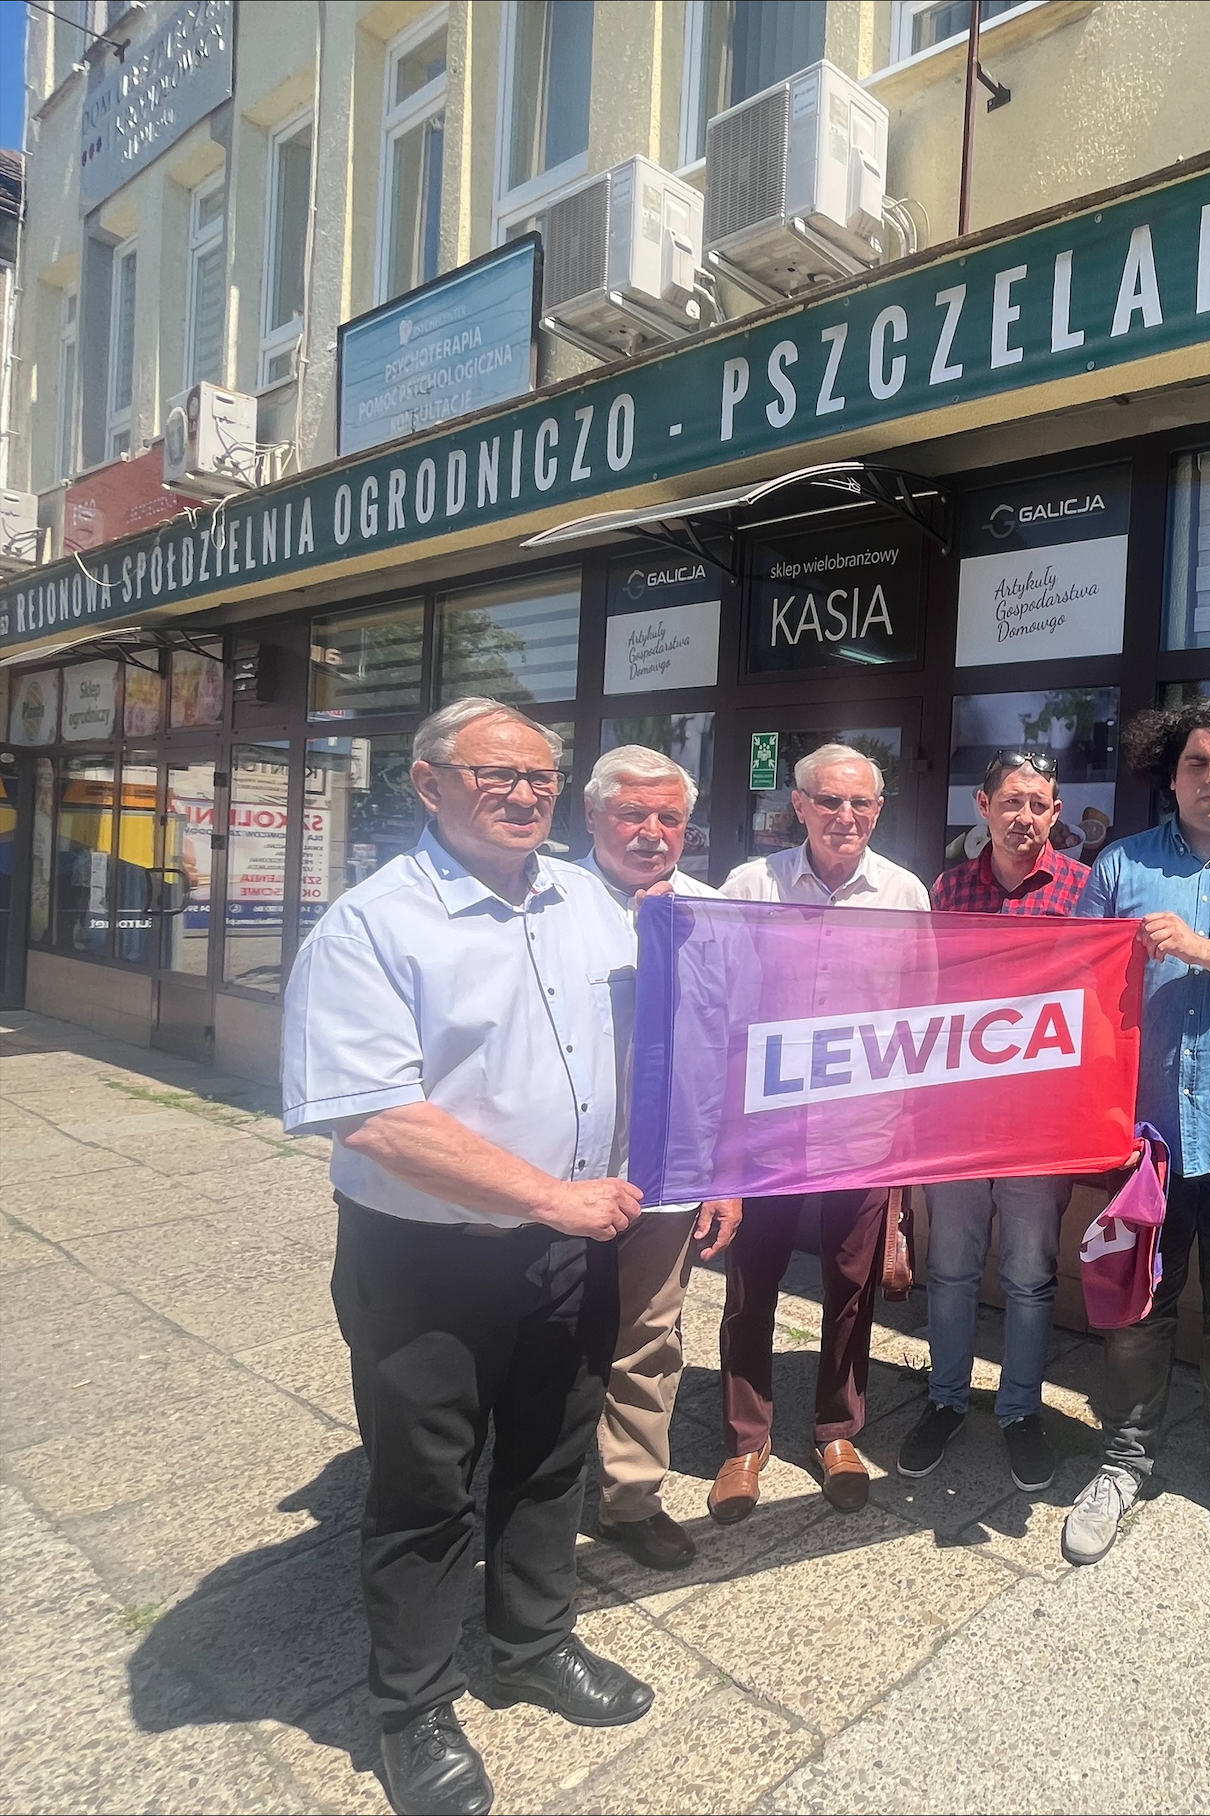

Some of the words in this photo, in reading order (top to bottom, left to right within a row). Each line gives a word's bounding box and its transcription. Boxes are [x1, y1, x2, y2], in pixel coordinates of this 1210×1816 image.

[385, 325, 483, 383] PSYCHOTERAPIA
[358, 388, 398, 422] POMOC
[400, 344, 513, 401] PSYCHOLOGICZNA
[390, 389, 472, 434] KONSULTACJE
[16, 563, 112, 633] REJONOWA
[121, 496, 315, 603] SPÓŁDZIELNIA
[333, 393, 635, 545] OGRODNICZO
[1018, 494, 1105, 523] GALICJA
[647, 564, 706, 587] GALICJA
[770, 561, 801, 579] sklep
[802, 548, 900, 574] wielobranżowy
[994, 564, 1058, 602] Artykuły
[770, 584, 894, 647] KASIA
[995, 583, 1100, 622] Gospodarstwa
[627, 621, 666, 648] Artykuły
[997, 613, 1068, 643] Domowgo
[628, 636, 691, 664] Gospodarstwa
[629, 659, 672, 681] Domowgo
[762, 1002, 1076, 1098] LEWICA
